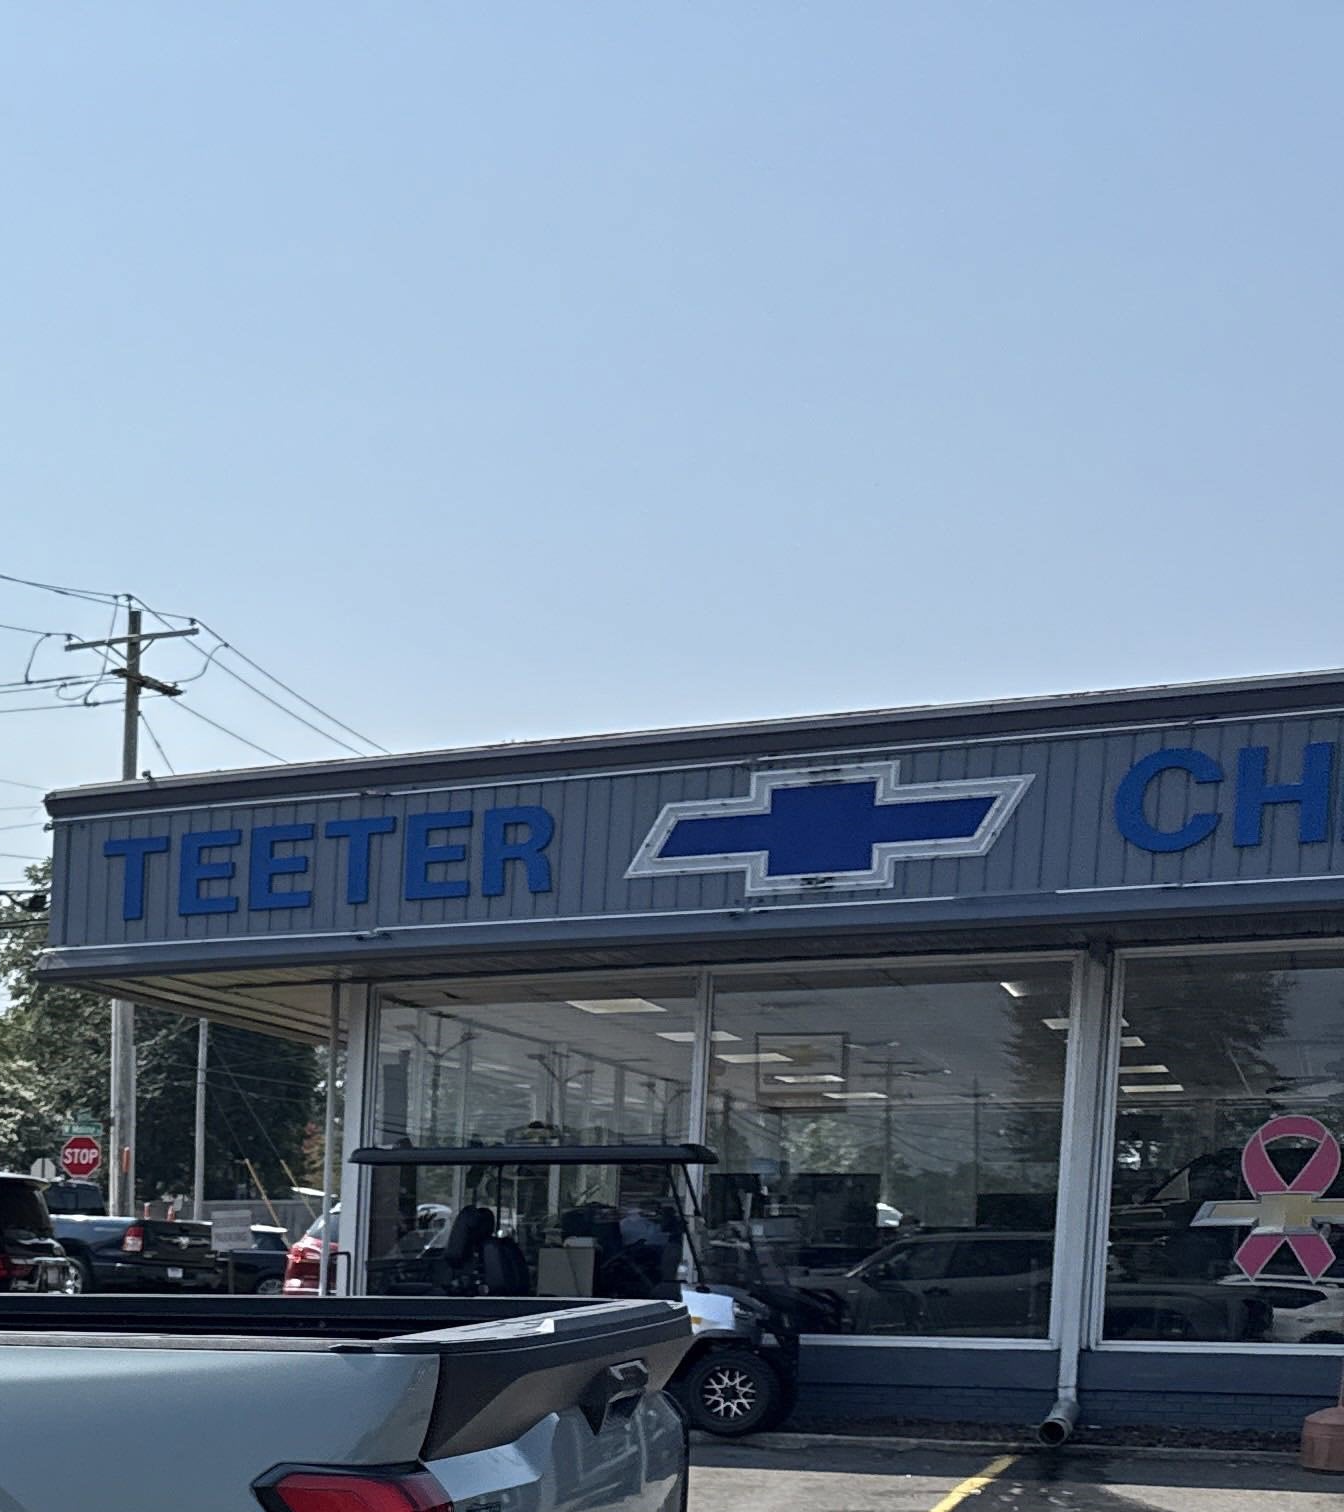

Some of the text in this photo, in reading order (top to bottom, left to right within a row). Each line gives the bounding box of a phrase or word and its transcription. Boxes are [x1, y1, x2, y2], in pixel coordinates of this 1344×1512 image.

[103, 742, 1344, 921] TEETER CH
[63, 1148, 99, 1165] STOP
